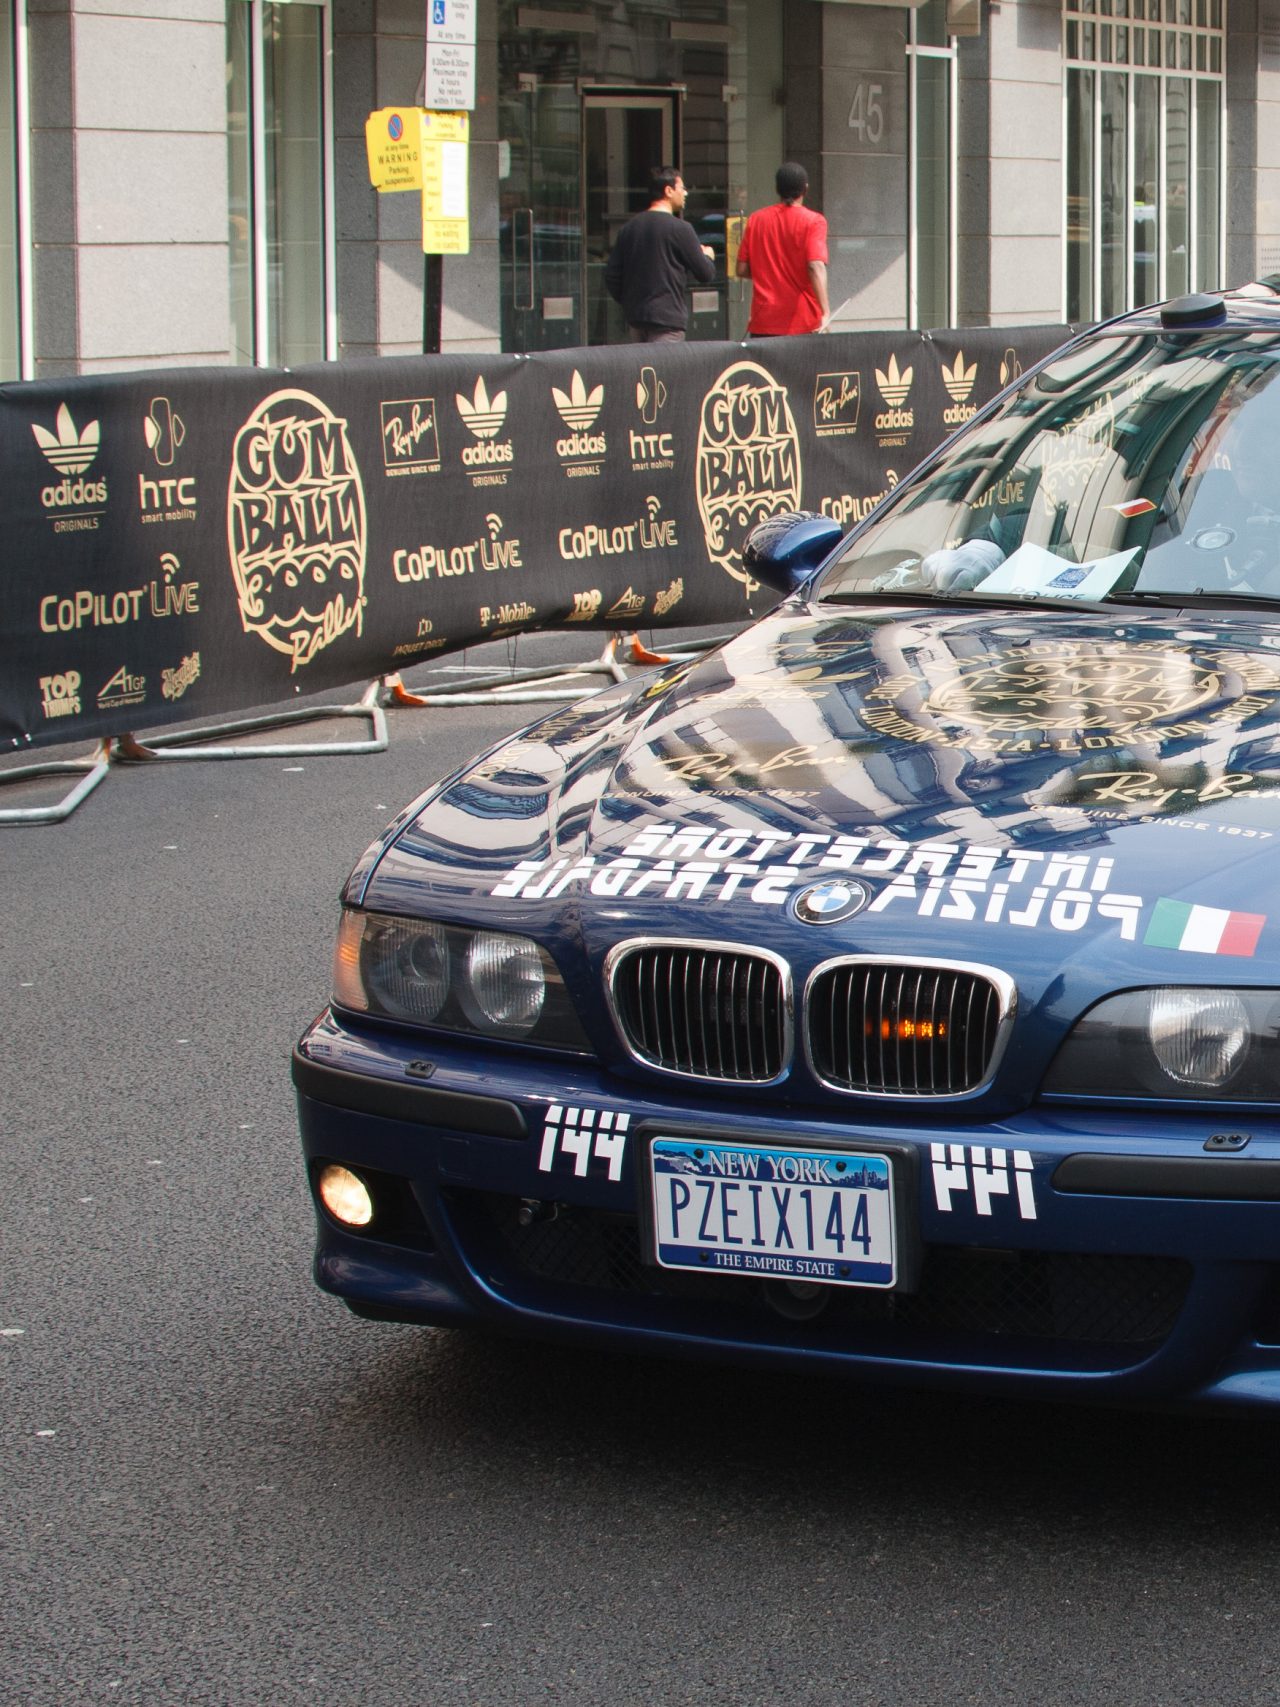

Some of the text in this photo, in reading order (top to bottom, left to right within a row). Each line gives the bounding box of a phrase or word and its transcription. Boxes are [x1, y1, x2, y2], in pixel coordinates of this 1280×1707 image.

[848, 83, 884, 143] 45
[377, 151, 418, 165] WARNING
[388, 166, 410, 175] Parking
[875, 409, 914, 429] adidas
[943, 404, 977, 424] adidas
[462, 440, 514, 466] adidas
[555, 433, 606, 459] adidas
[628, 430, 675, 460] htc
[878, 436, 907, 448] ORIGINALS
[566, 464, 601, 479] ORIGINALS
[632, 458, 675, 473] smart mobility
[699, 441, 798, 501] BALL
[41, 478, 107, 508] adidas
[138, 473, 197, 510] htc
[472, 474, 508, 488] ORIGINALS
[54, 517, 99, 534] ORIGINALS
[141, 508, 197, 524] smart mobility
[230, 480, 361, 556] BALL
[573, 588, 602, 613] TOP
[39, 670, 81, 701] TOP
[943, 734, 1034, 753] ASIA
[1058, 720, 1212, 751] LONDON
[696, 788, 764, 798] SINCE
[1029, 805, 1273, 840] GENUINE SINCE 1937
[538, 1104, 632, 1182] 144
[708, 1150, 833, 1184] NEW YORK
[670, 1177, 872, 1256] PZEIX144
[714, 1252, 836, 1277] THE EMPIRE STATE
